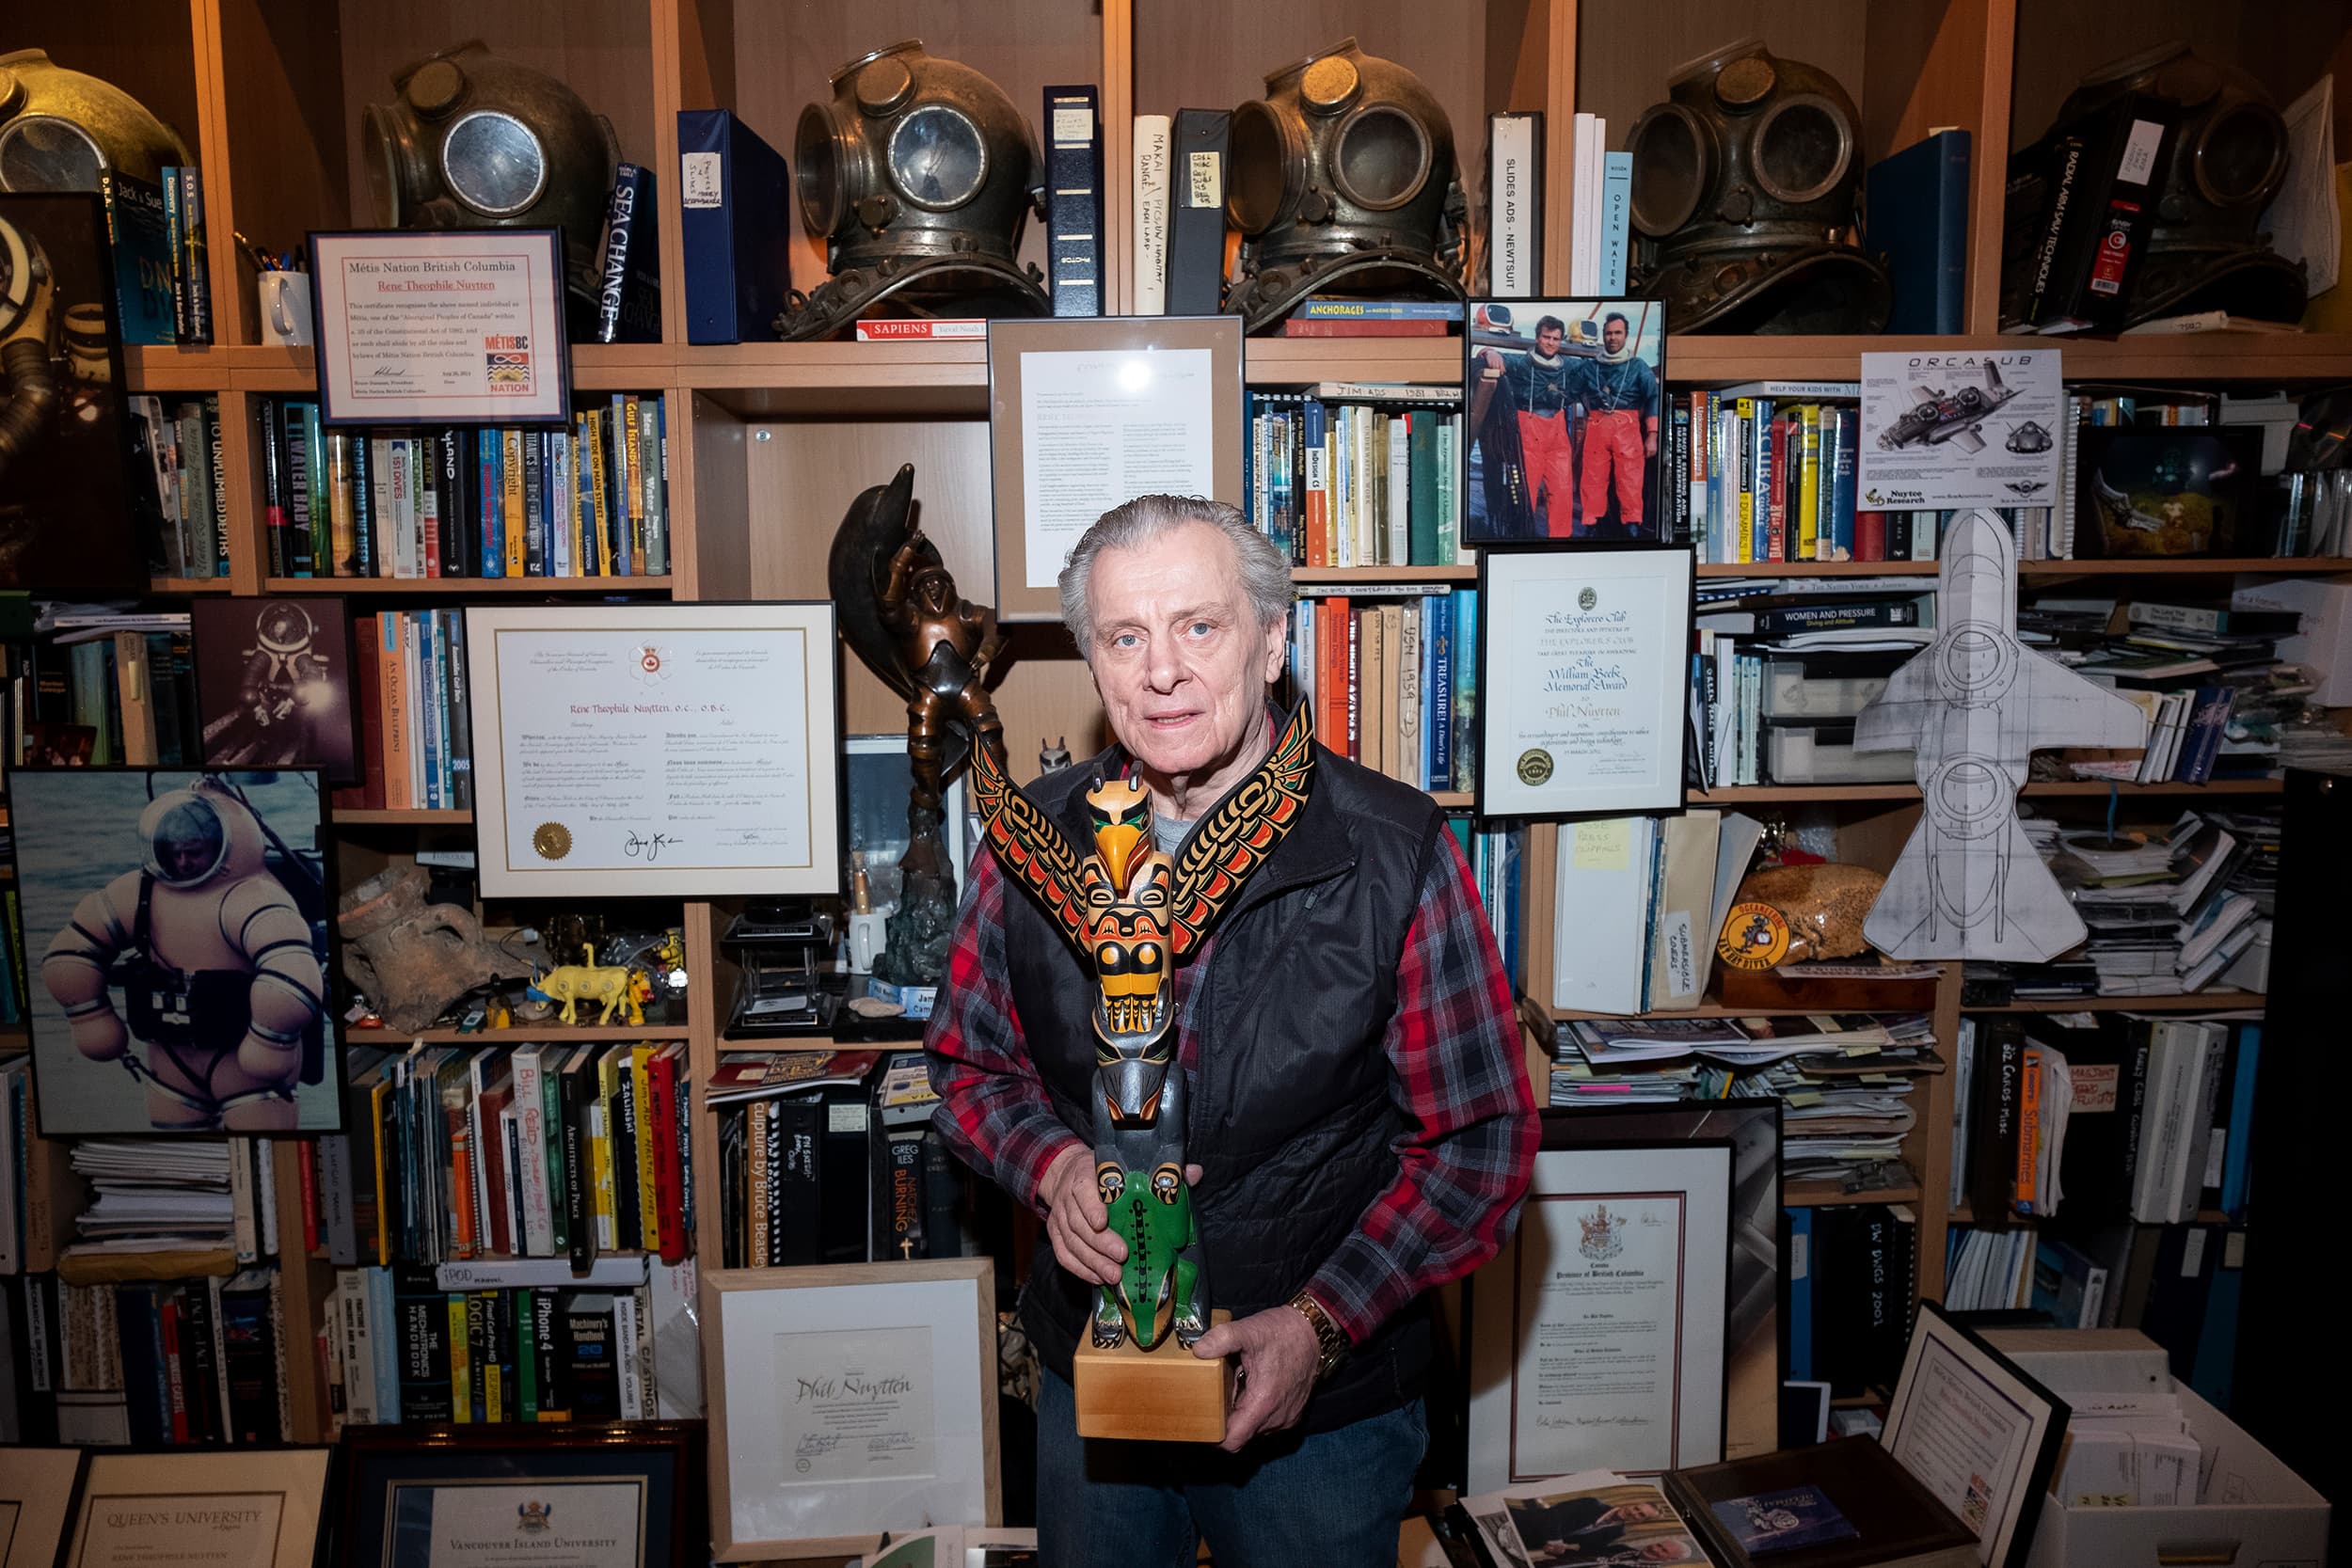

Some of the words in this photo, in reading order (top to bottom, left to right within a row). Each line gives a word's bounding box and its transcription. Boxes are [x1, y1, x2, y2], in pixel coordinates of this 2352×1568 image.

[1506, 159, 1516, 197] SLIDES
[2061, 150, 2080, 186] RADIAL
[167, 177, 176, 214] Discovery
[611, 184, 634, 226] SEA
[1506, 200, 1515, 223] ADS
[2055, 186, 2071, 211] ARM
[1613, 194, 1622, 231] OPEN
[2049, 211, 2064, 236] SAW
[349, 262, 380, 274] Métis
[383, 263, 421, 273] Nation
[423, 261, 460, 272] British
[464, 261, 516, 272] Columbia
[599, 227, 628, 320] CHANGE
[1505, 234, 1515, 289] NEWTSUIT
[1610, 240, 1619, 287] WATER
[2034, 236, 2058, 293] TECHNIQUES
[377, 282, 404, 292] Rene
[406, 281, 453, 293] Theophile
[1310, 305, 1364, 315] ANCHORAGES
[874, 324, 928, 334] SAPIENS
[490, 384, 529, 392] NATION
[1338, 388, 1362, 396] JIM
[627, 403, 637, 425] GULF
[643, 413, 653, 436] Men
[1711, 396, 1720, 421] NORTH
[1695, 406, 1704, 446] Unknown
[351, 436, 365, 477] ESCAPE
[526, 433, 539, 466] TITANIC'S
[592, 457, 599, 469] ON
[627, 429, 638, 467] ISLANDS
[644, 439, 652, 474] Under
[1695, 448, 1704, 477] Waters
[212, 440, 228, 514] UNPLUMBED
[290, 440, 307, 490] WATER
[504, 437, 519, 496] Copyright
[593, 471, 601, 491] MAIN
[352, 480, 366, 512] FROM
[393, 471, 402, 499] DIVES
[645, 476, 655, 512] Water
[1886, 496, 1925, 504] Research
[293, 494, 309, 531] BABY
[595, 492, 603, 518] STREET
[216, 515, 229, 557] DEPTHS
[355, 515, 367, 532] THE
[1740, 501, 1749, 549] DUMMIES
[356, 535, 369, 563] DEEP
[1785, 612, 1818, 622] WOMEN
[1820, 610, 1837, 620] AND
[1838, 608, 1876, 619] PRESSURE
[389, 660, 398, 674] AN
[423, 660, 433, 702] Underwater
[389, 675, 399, 705] OCEAN
[1437, 657, 1447, 721] TREASURE!
[426, 703, 436, 747] Archaeology
[570, 704, 589, 715] Rene
[592, 703, 629, 716] Theophile
[391, 707, 400, 752] BLUEPRINT
[621, 1081, 633, 1133] ZALINSKI
[566, 1125, 580, 1178] ARCHITECTS
[891, 1146, 919, 1157] GREG
[896, 1156, 915, 1164] ILES
[2021, 1109, 2038, 1184] Submarines
[570, 1179, 579, 1191] OF
[751, 1161, 767, 1177] by
[570, 1193, 581, 1220] PEACE
[755, 1181, 768, 1220] Bruce
[894, 1168, 908, 1232] BURNING
[907, 1177, 919, 1224] NATCHEZ
[753, 1223, 769, 1269] Beasley
[469, 1294, 483, 1337] LOGIC
[485, 1300, 496, 1320] Final
[537, 1298, 551, 1340] iPhone
[635, 1295, 644, 1341] METAL
[408, 1305, 420, 1377] HANDBOOK
[418, 1305, 430, 1377] MECHATRONICS
[428, 1331, 438, 1350] THE
[486, 1321, 496, 1336] Cut
[486, 1336, 497, 1349] Pro
[488, 1349, 497, 1363] HD
[540, 1342, 554, 1351] 4
[622, 1324, 631, 1373] BAND-IN-A-BOX
[107, 1512, 169, 1528] QUEEN'S
[175, 1511, 262, 1525] UNIVERSITY
[450, 1541, 510, 1551] VANCOUVER
[515, 1538, 550, 1548] ISLAND
[554, 1537, 616, 1548] UNIVERSITY
